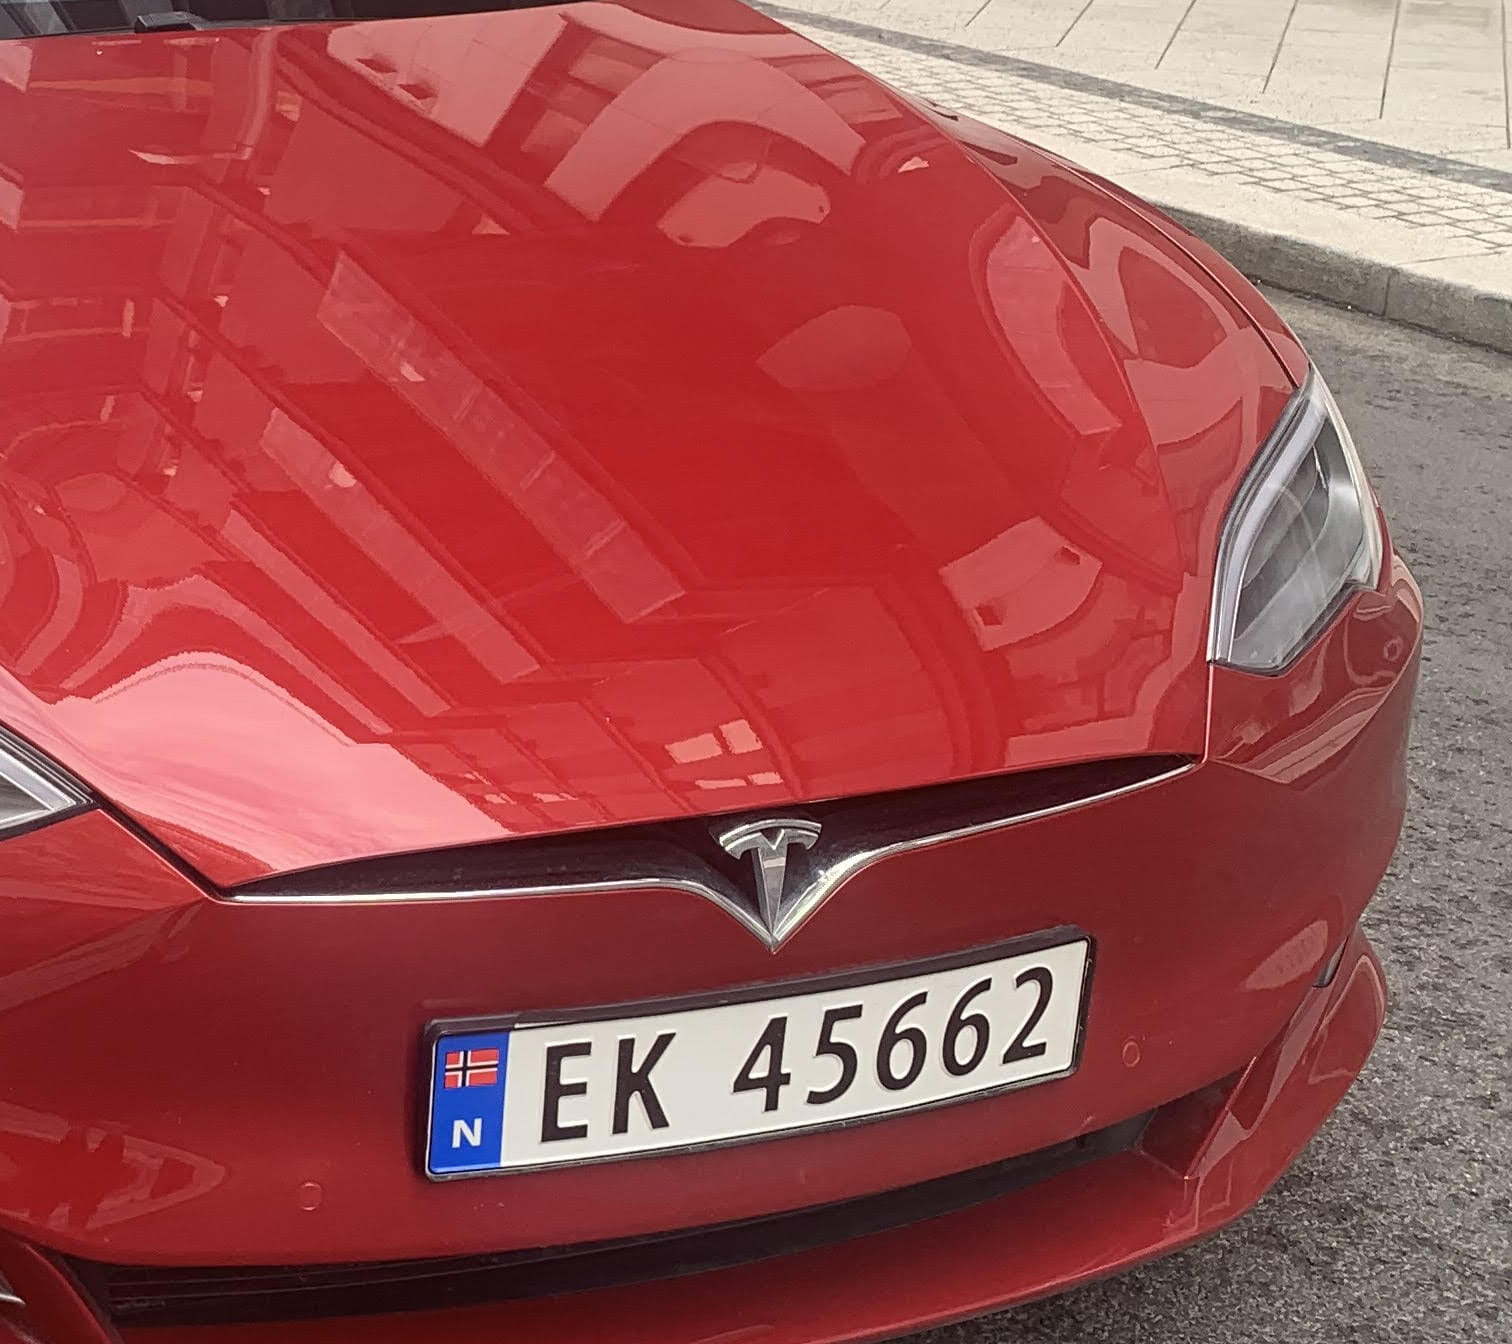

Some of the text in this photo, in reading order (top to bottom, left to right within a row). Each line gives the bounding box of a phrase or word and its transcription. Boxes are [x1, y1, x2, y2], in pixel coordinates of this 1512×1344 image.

[540, 966, 1054, 1143] EK 45662
[451, 1117, 483, 1149] N
